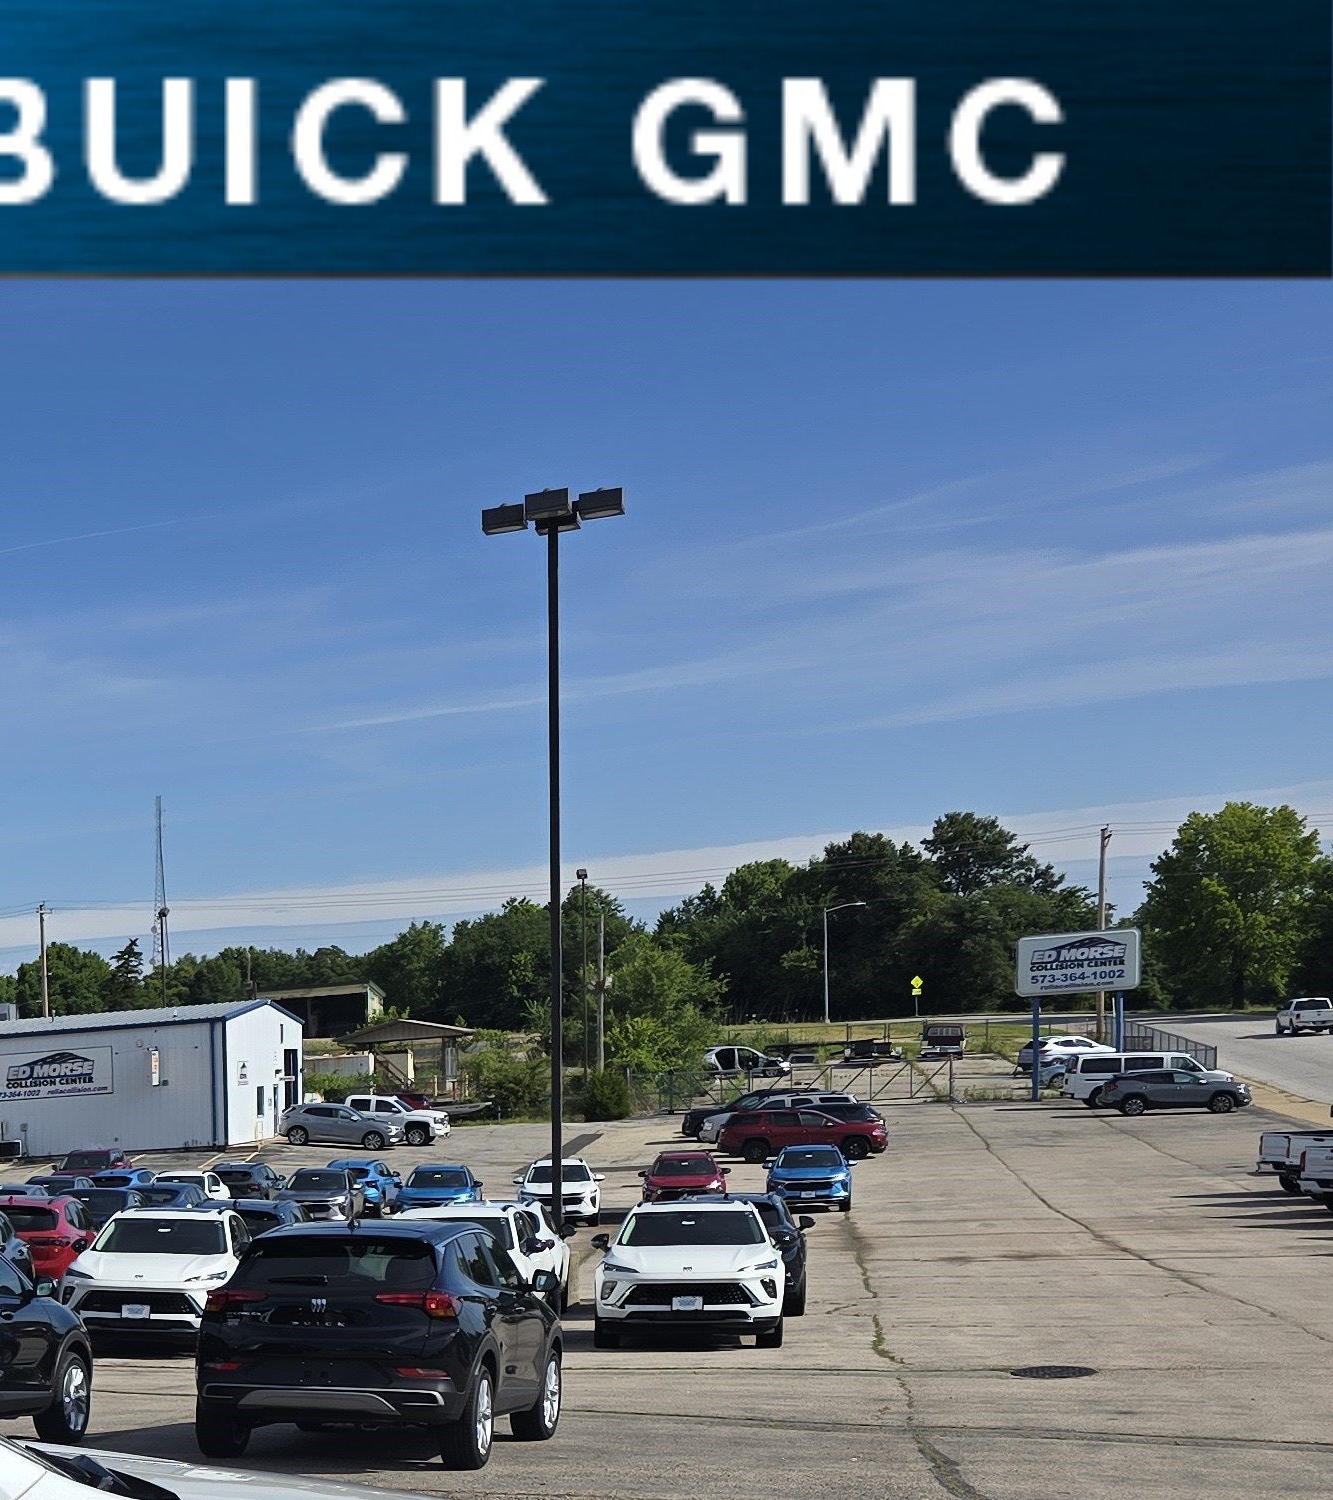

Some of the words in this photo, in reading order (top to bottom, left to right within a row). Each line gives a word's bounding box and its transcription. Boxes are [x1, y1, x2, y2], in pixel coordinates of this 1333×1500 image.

[1032, 950, 1057, 963] ED
[1059, 945, 1126, 961] MORSE
[1030, 961, 1084, 972] COLLISION
[1087, 959, 1125, 968] CENTER
[1030, 969, 1125, 984] 573-364-1002
[8, 1065, 31, 1080] ED
[33, 1060, 94, 1077] MORSE
[6, 1079, 56, 1089] COLLISION
[58, 1076, 94, 1086] CENTER
